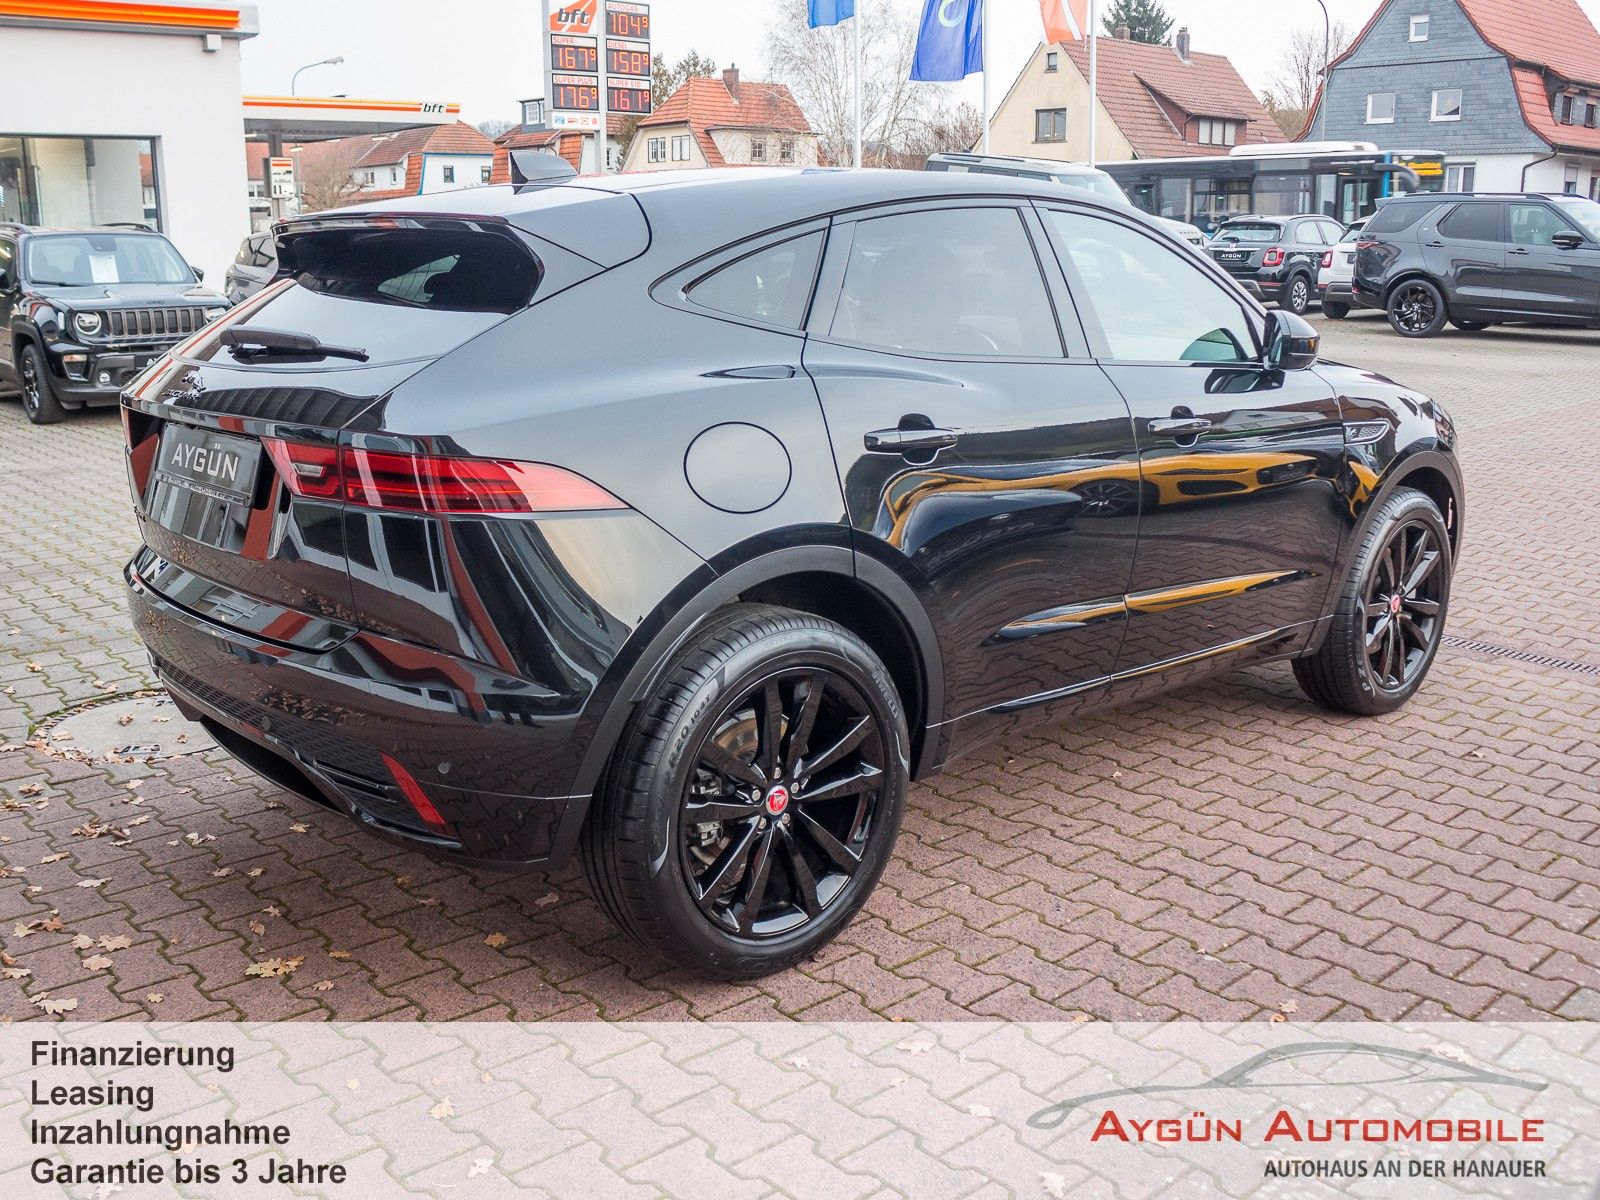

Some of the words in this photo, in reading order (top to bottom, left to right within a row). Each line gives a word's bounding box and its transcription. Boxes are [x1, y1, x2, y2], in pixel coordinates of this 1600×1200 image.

[557, 8, 590, 25] bft
[553, 36, 575, 45] SUPER
[608, 40, 628, 50] DIESEL
[554, 75, 576, 84] SUPER
[577, 76, 594, 85] PLUS
[609, 79, 629, 88] SUPER
[423, 103, 444, 113] bft
[171, 442, 239, 481] AYGÜN
